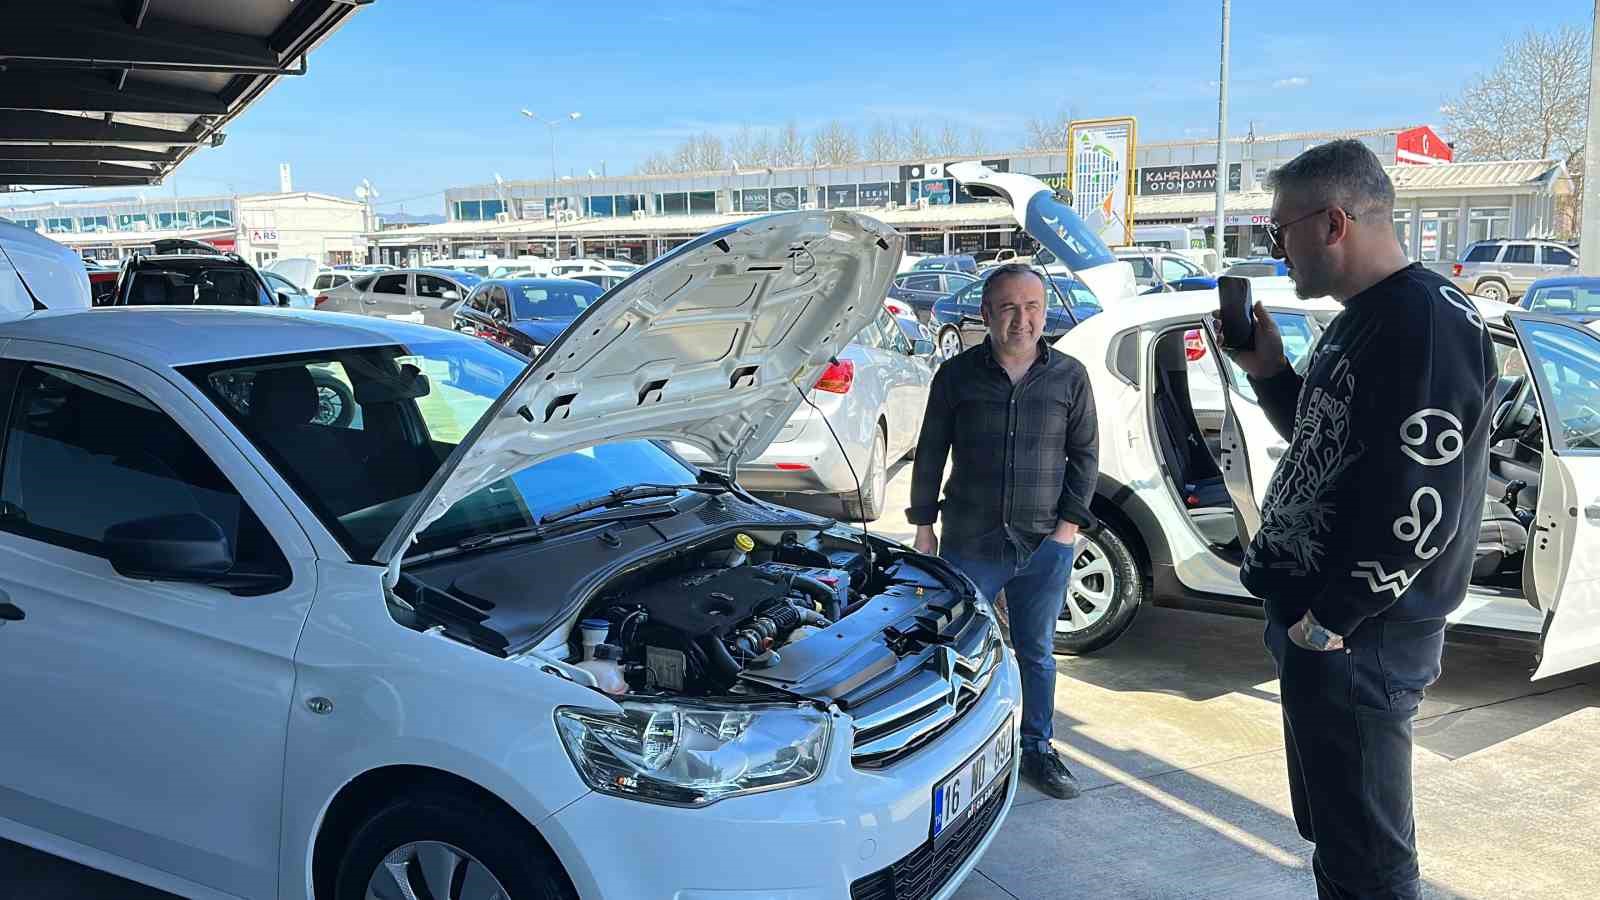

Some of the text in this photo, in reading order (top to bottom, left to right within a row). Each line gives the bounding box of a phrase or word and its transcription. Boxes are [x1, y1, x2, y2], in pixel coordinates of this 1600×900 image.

[1145, 168, 1217, 182] KAHRAMAN
[945, 778, 961, 822] 16
[971, 753, 986, 798] ND
